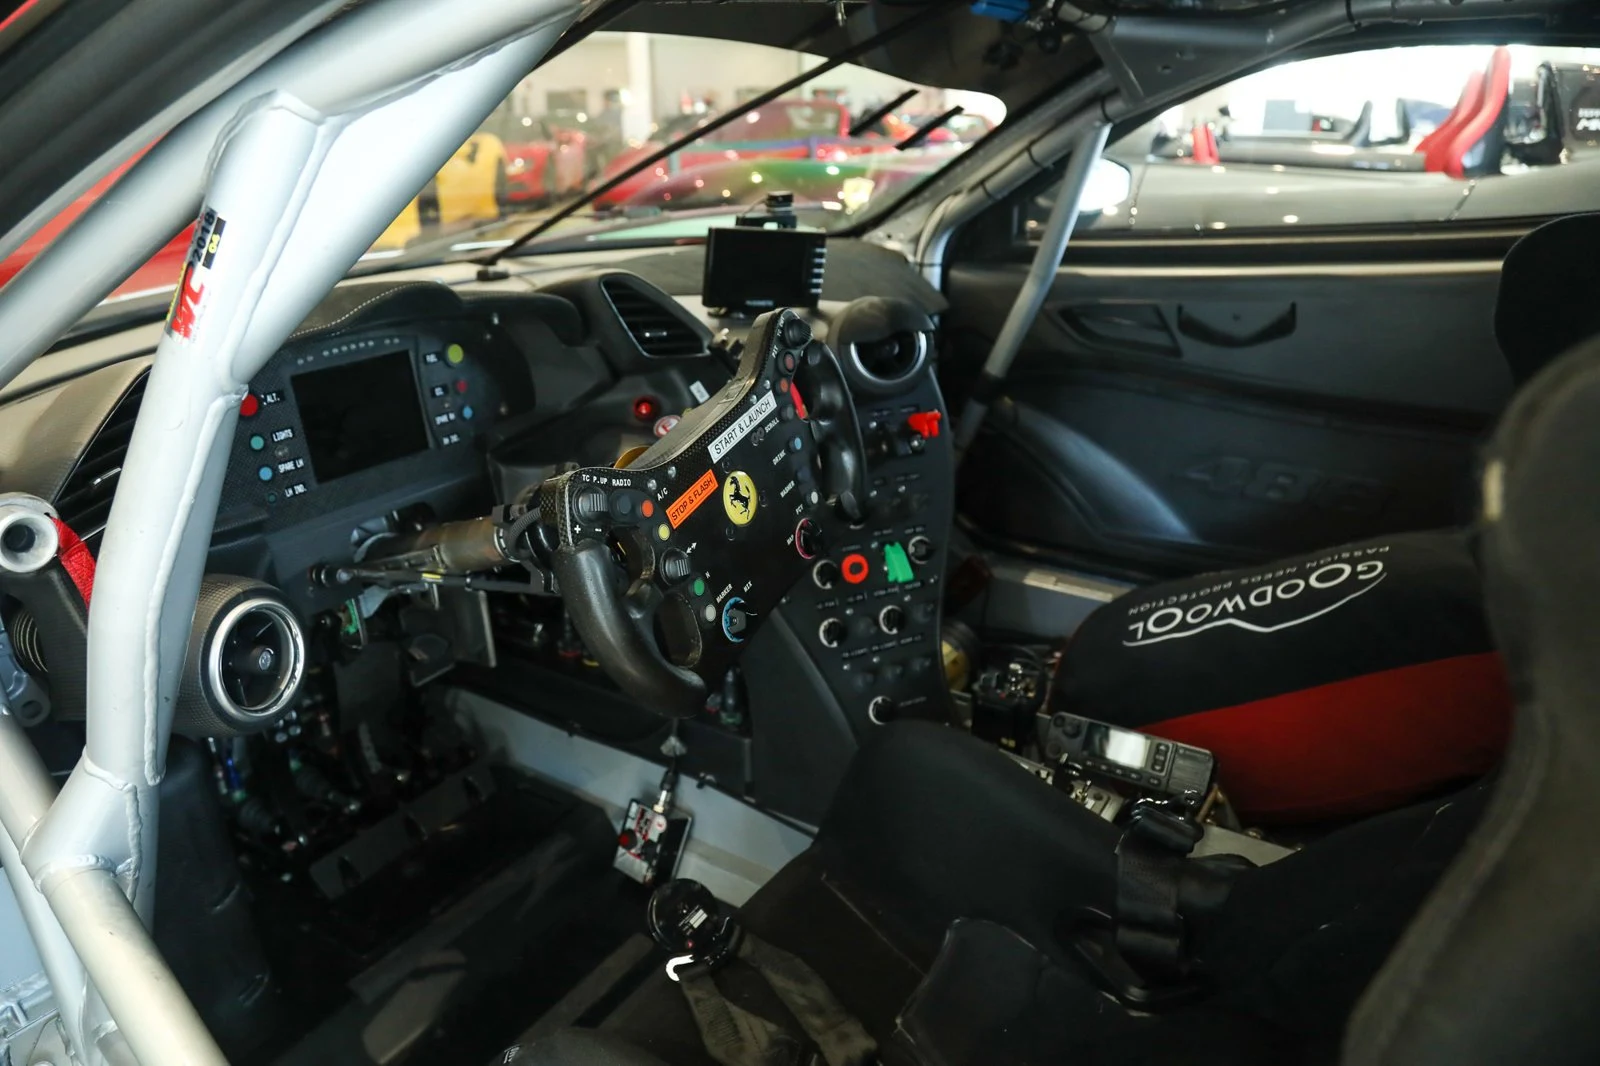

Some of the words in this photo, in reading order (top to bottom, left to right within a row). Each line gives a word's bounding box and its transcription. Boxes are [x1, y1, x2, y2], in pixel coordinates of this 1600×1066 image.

[193, 211, 215, 262] 2018
[714, 429, 739, 455] START
[739, 422, 746, 433] &
[744, 399, 772, 429] LAUNCH
[765, 417, 780, 433] SCROLL
[272, 429, 293, 443] LIGHTS
[772, 449, 787, 466] DRINK
[278, 461, 295, 474] SPARE
[582, 473, 590, 482] TC
[612, 478, 632, 487] RADIO
[657, 487, 669, 502] A/C
[671, 501, 688, 522] STOP
[688, 494, 695, 505] &
[694, 480, 714, 501] FLASH
[1306, 546, 1390, 569] PASSION
[1240, 566, 1299, 585] NEEDS
[716, 584, 733, 604] MARKER
[1128, 580, 1234, 616] PROTECTION
[1128, 560, 1384, 641] GOODWOOL
